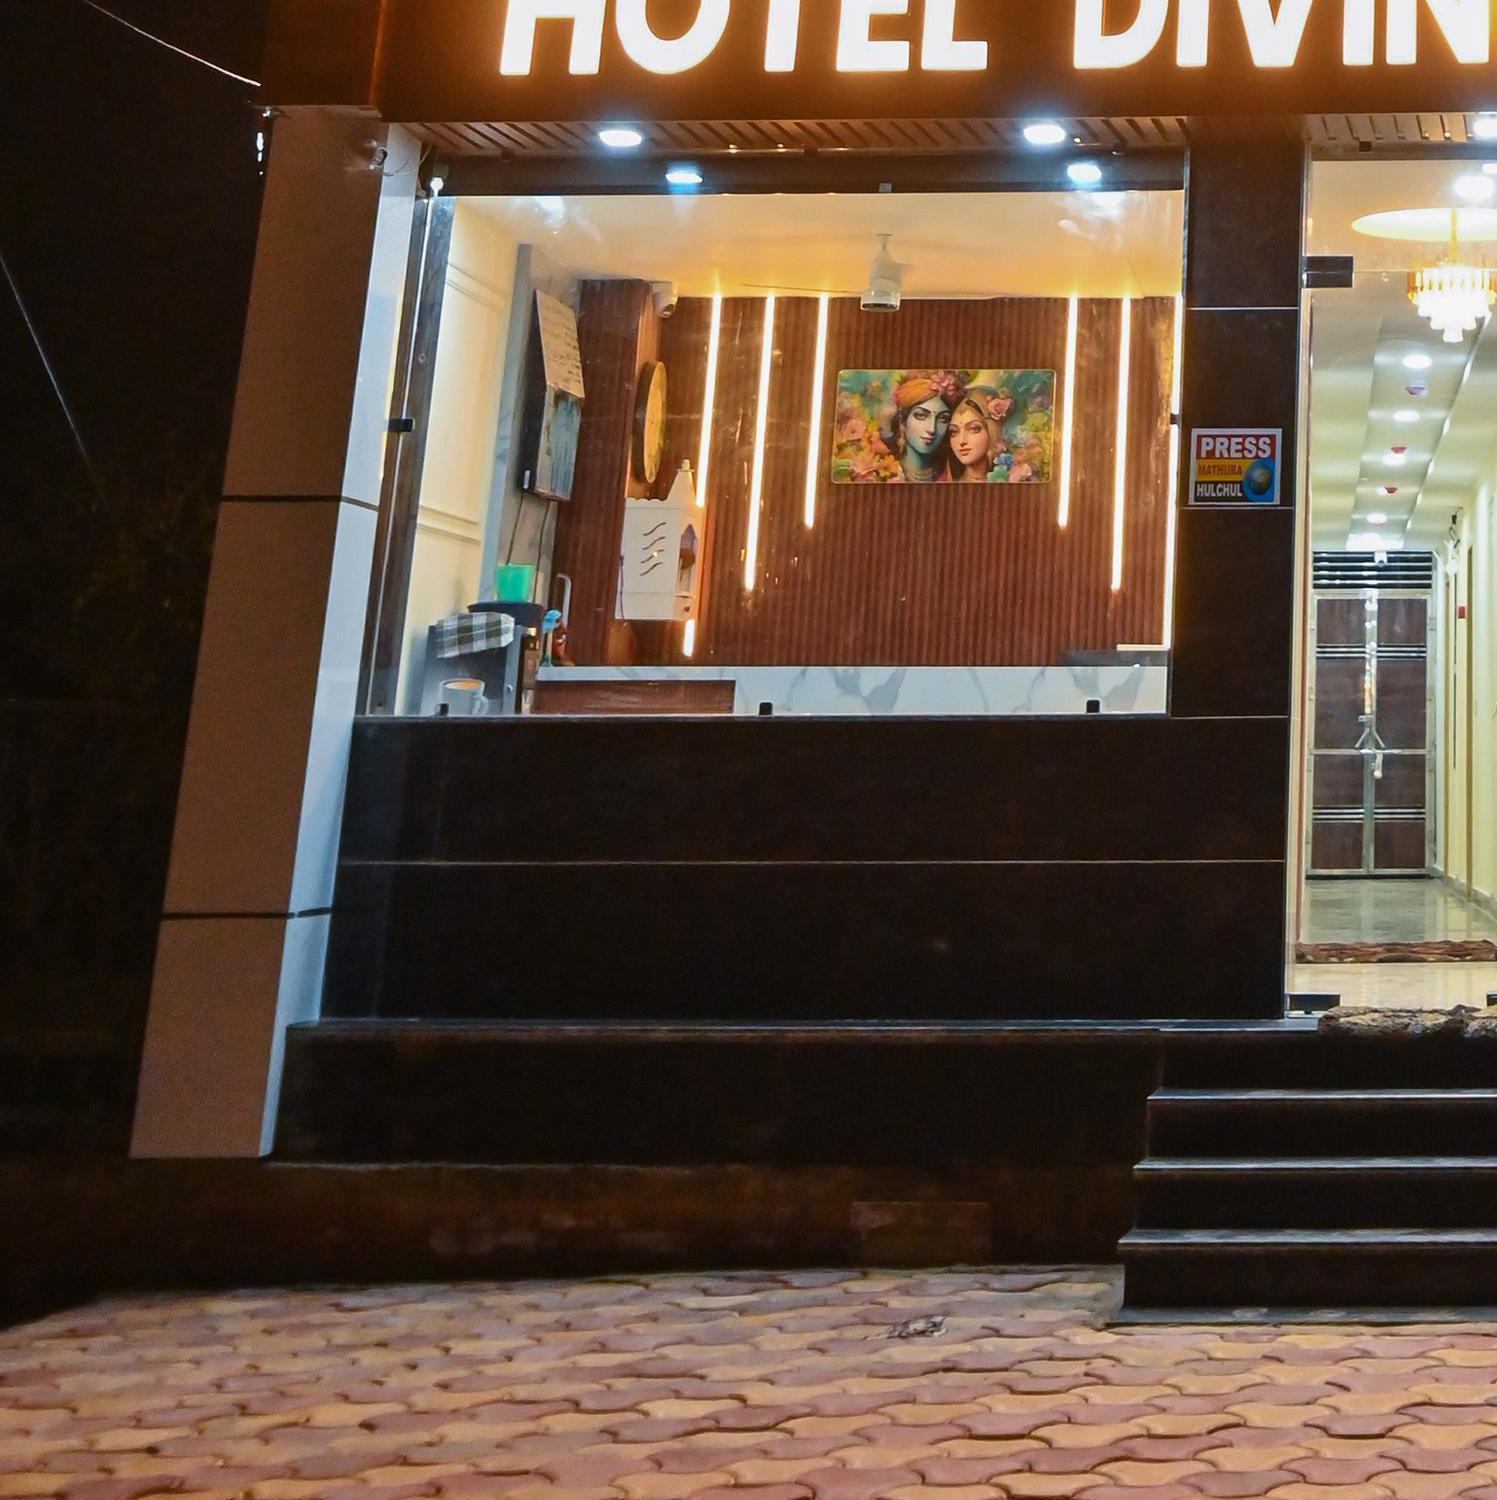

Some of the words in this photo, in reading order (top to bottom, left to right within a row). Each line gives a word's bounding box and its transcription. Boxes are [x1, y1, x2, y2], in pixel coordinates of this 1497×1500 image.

[1201, 437, 1271, 458] PRESS
[1198, 464, 1242, 476] MATHURA
[1197, 483, 1242, 497] HULCHUL
